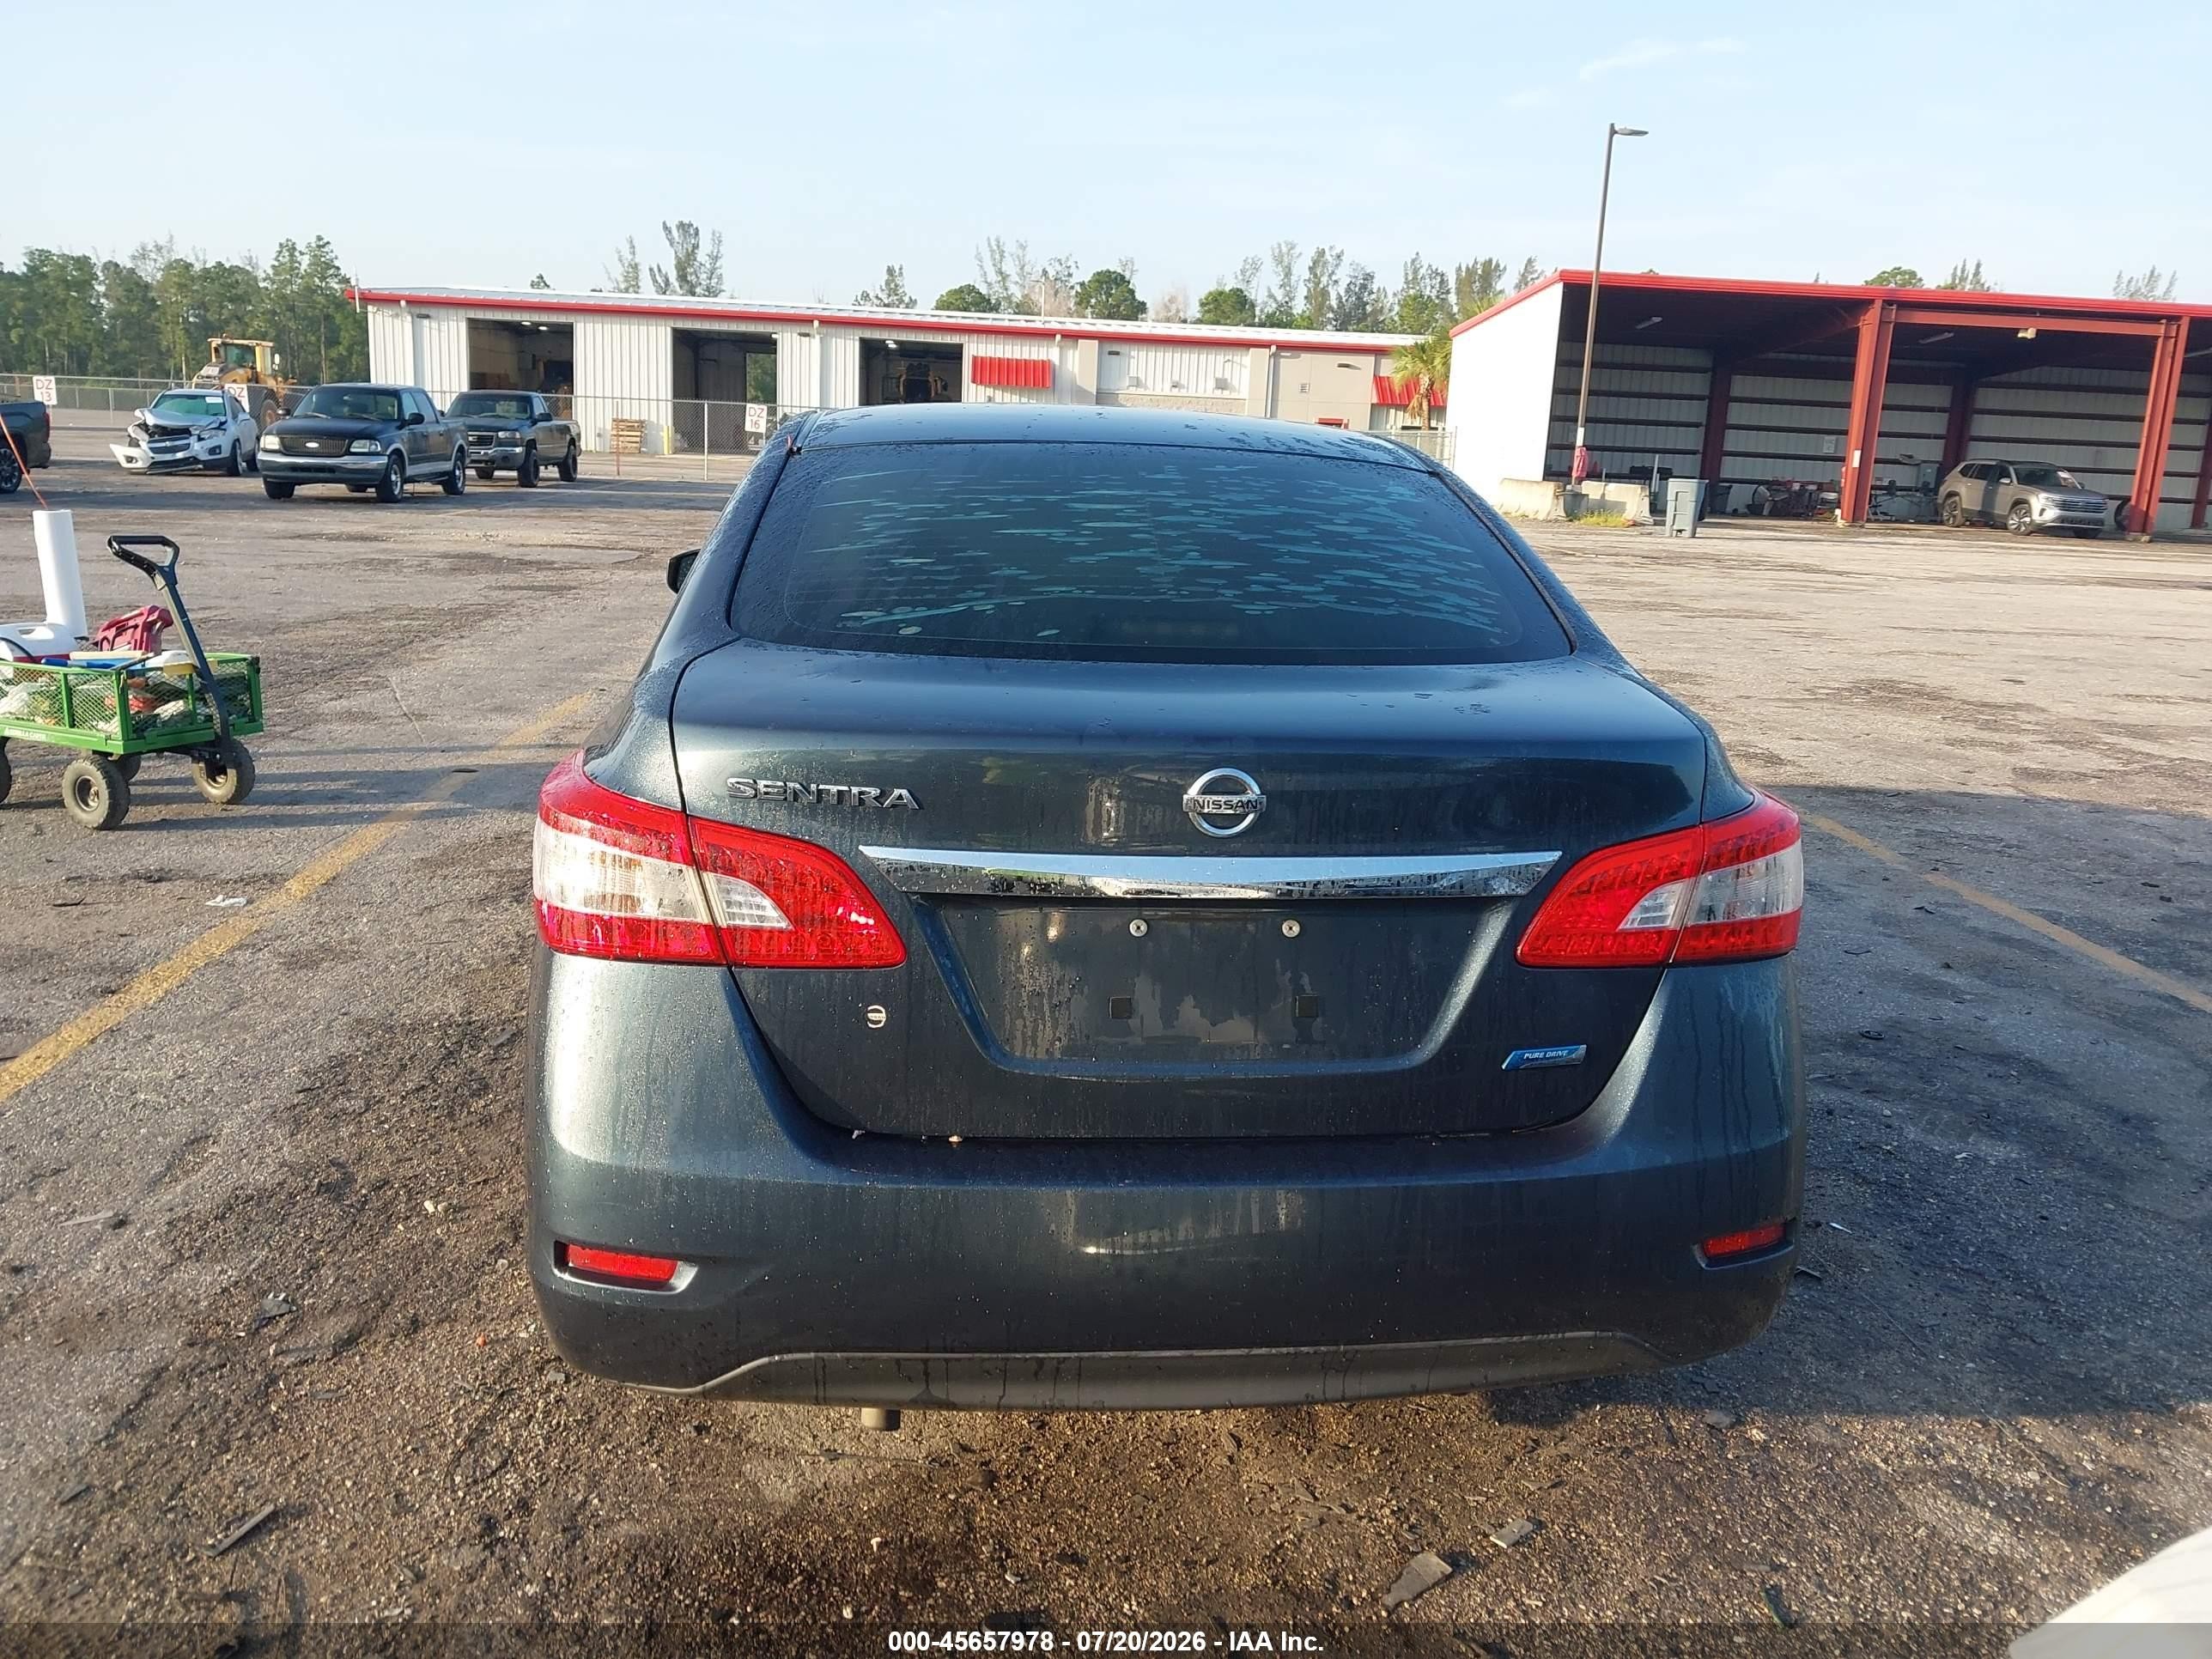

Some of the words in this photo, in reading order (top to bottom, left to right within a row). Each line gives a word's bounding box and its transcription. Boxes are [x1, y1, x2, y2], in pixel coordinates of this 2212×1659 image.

[35, 379, 53, 390] DZ
[40, 391, 52, 402] 13
[748, 406, 765, 418] DZ
[750, 418, 761, 429] 16
[726, 776, 920, 811] SENTRA
[1193, 799, 1258, 811] NISSAN
[1523, 1051, 1546, 1060] PURE
[1546, 1049, 1569, 1058] DRIVE
